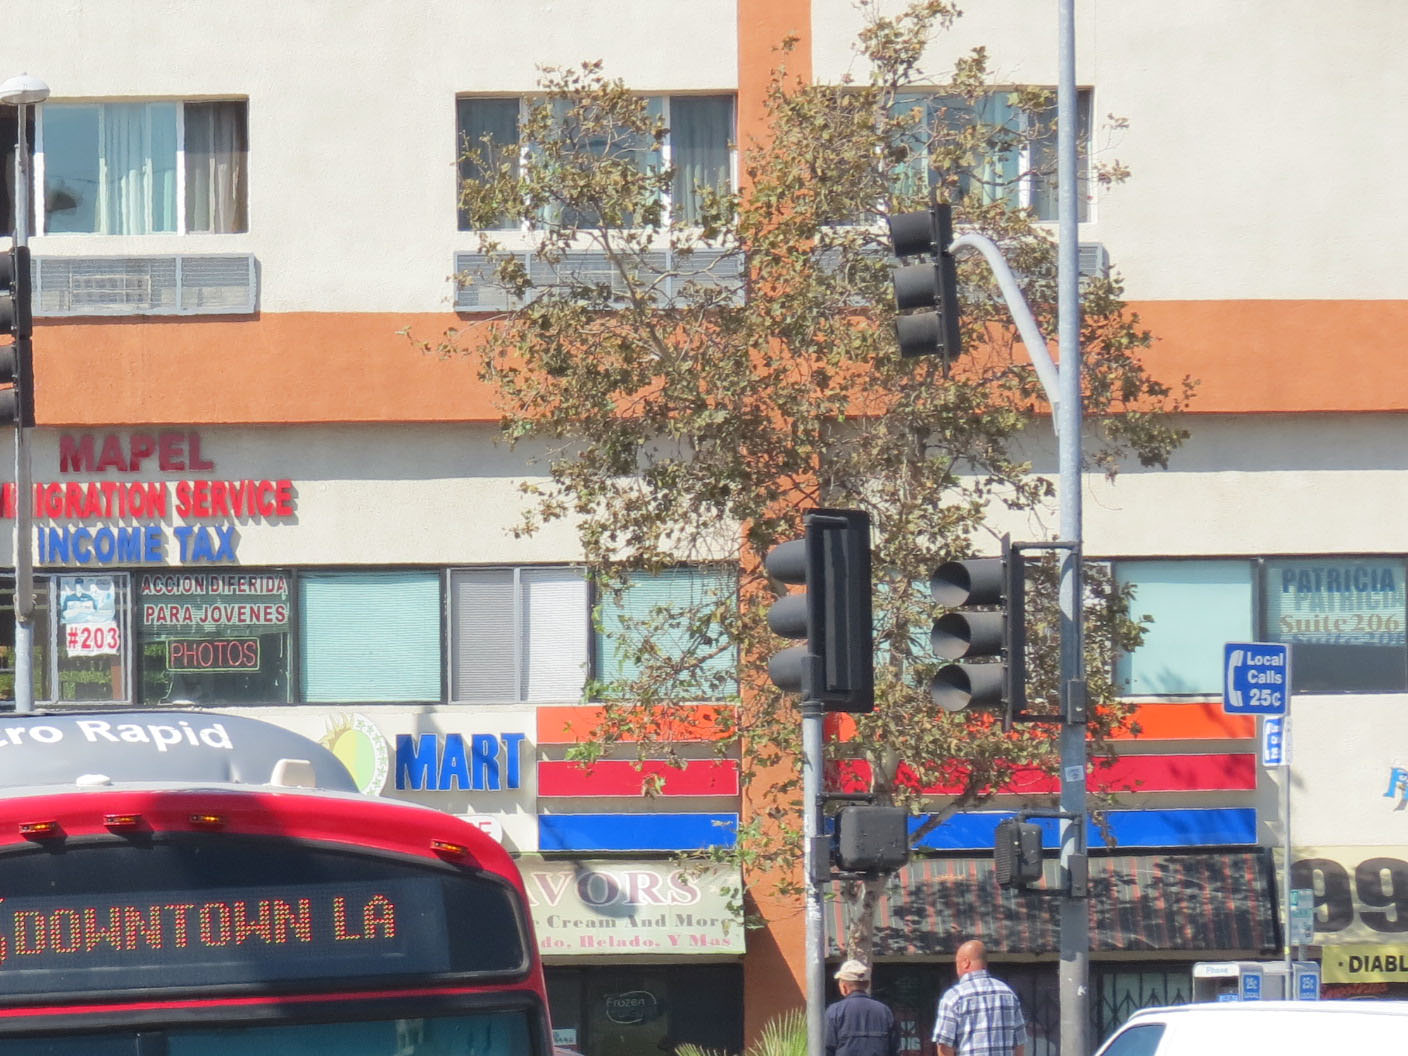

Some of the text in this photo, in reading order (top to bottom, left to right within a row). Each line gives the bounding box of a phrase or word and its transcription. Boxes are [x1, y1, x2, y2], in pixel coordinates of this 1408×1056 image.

[59, 434, 214, 473] MAPEL
[175, 479, 294, 518] SERVICE
[38, 525, 237, 564] INCOME TAX
[143, 574, 289, 595] ACCION DIFERIDA
[1281, 567, 1396, 593] PATRICIA
[145, 603, 287, 624] PARA JOVENES
[1280, 612, 1400, 633] Suite 206
[67, 627, 120, 650] #203
[170, 641, 258, 668] PHOTOS
[1247, 651, 1284, 666] Local
[1247, 669, 1282, 684] Calls
[1249, 688, 1281, 708] 25¢
[76, 719, 234, 753] Rapid
[395, 732, 526, 792] MART
[529, 870, 702, 907] VORS
[12, 897, 313, 956] DOWNTOWN
[332, 894, 396, 943] LA
[546, 913, 617, 929] Cream
[624, 913, 667, 928] And
[667, 934, 681, 947] Y
[688, 933, 732, 947] Mas
